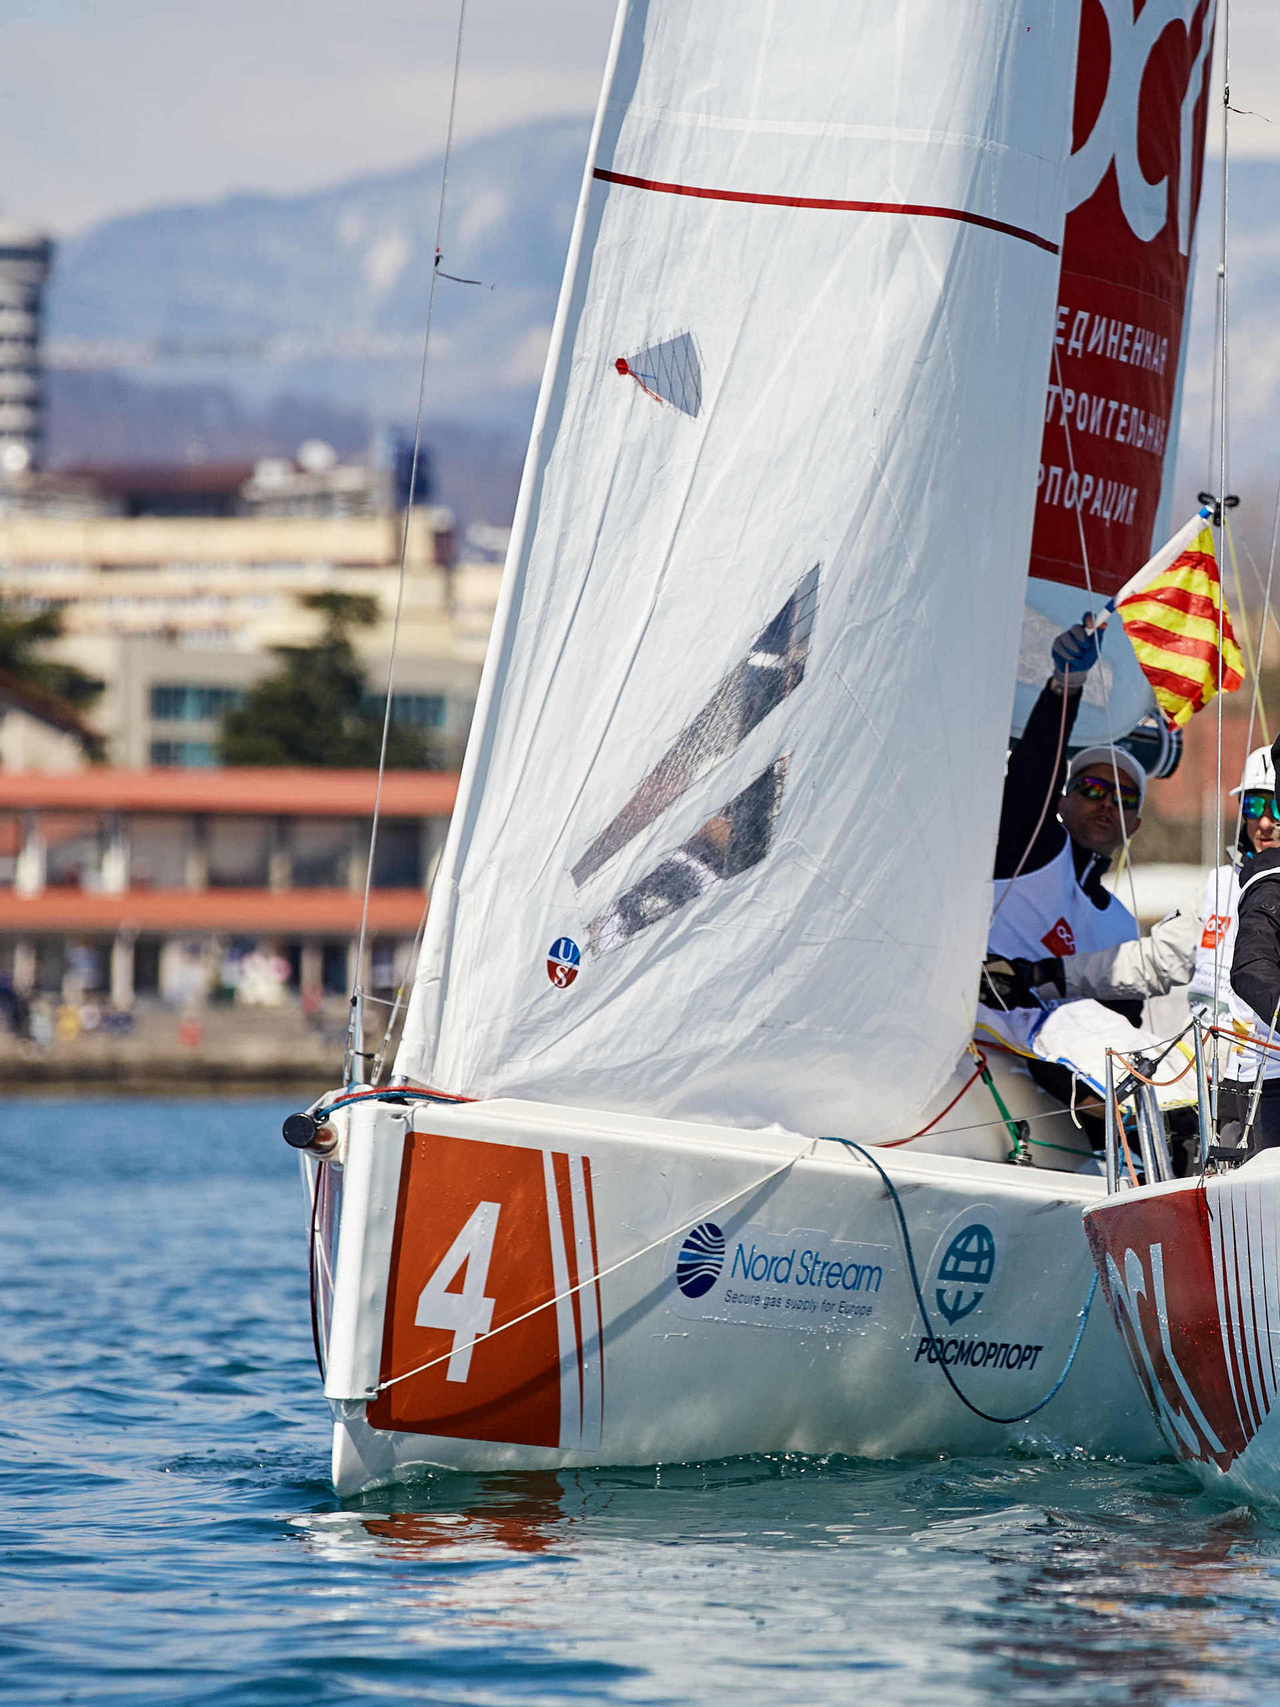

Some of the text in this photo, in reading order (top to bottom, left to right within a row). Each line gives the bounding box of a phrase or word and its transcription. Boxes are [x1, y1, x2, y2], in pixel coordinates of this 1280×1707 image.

[730, 1243, 884, 1293] Nord Stream
[414, 1200, 501, 1383] 4
[724, 1289, 761, 1307] Secure
[763, 1295, 783, 1310] gas
[821, 1299, 837, 1313] for
[914, 1336, 1044, 1371] РОСМОРПОРТ
